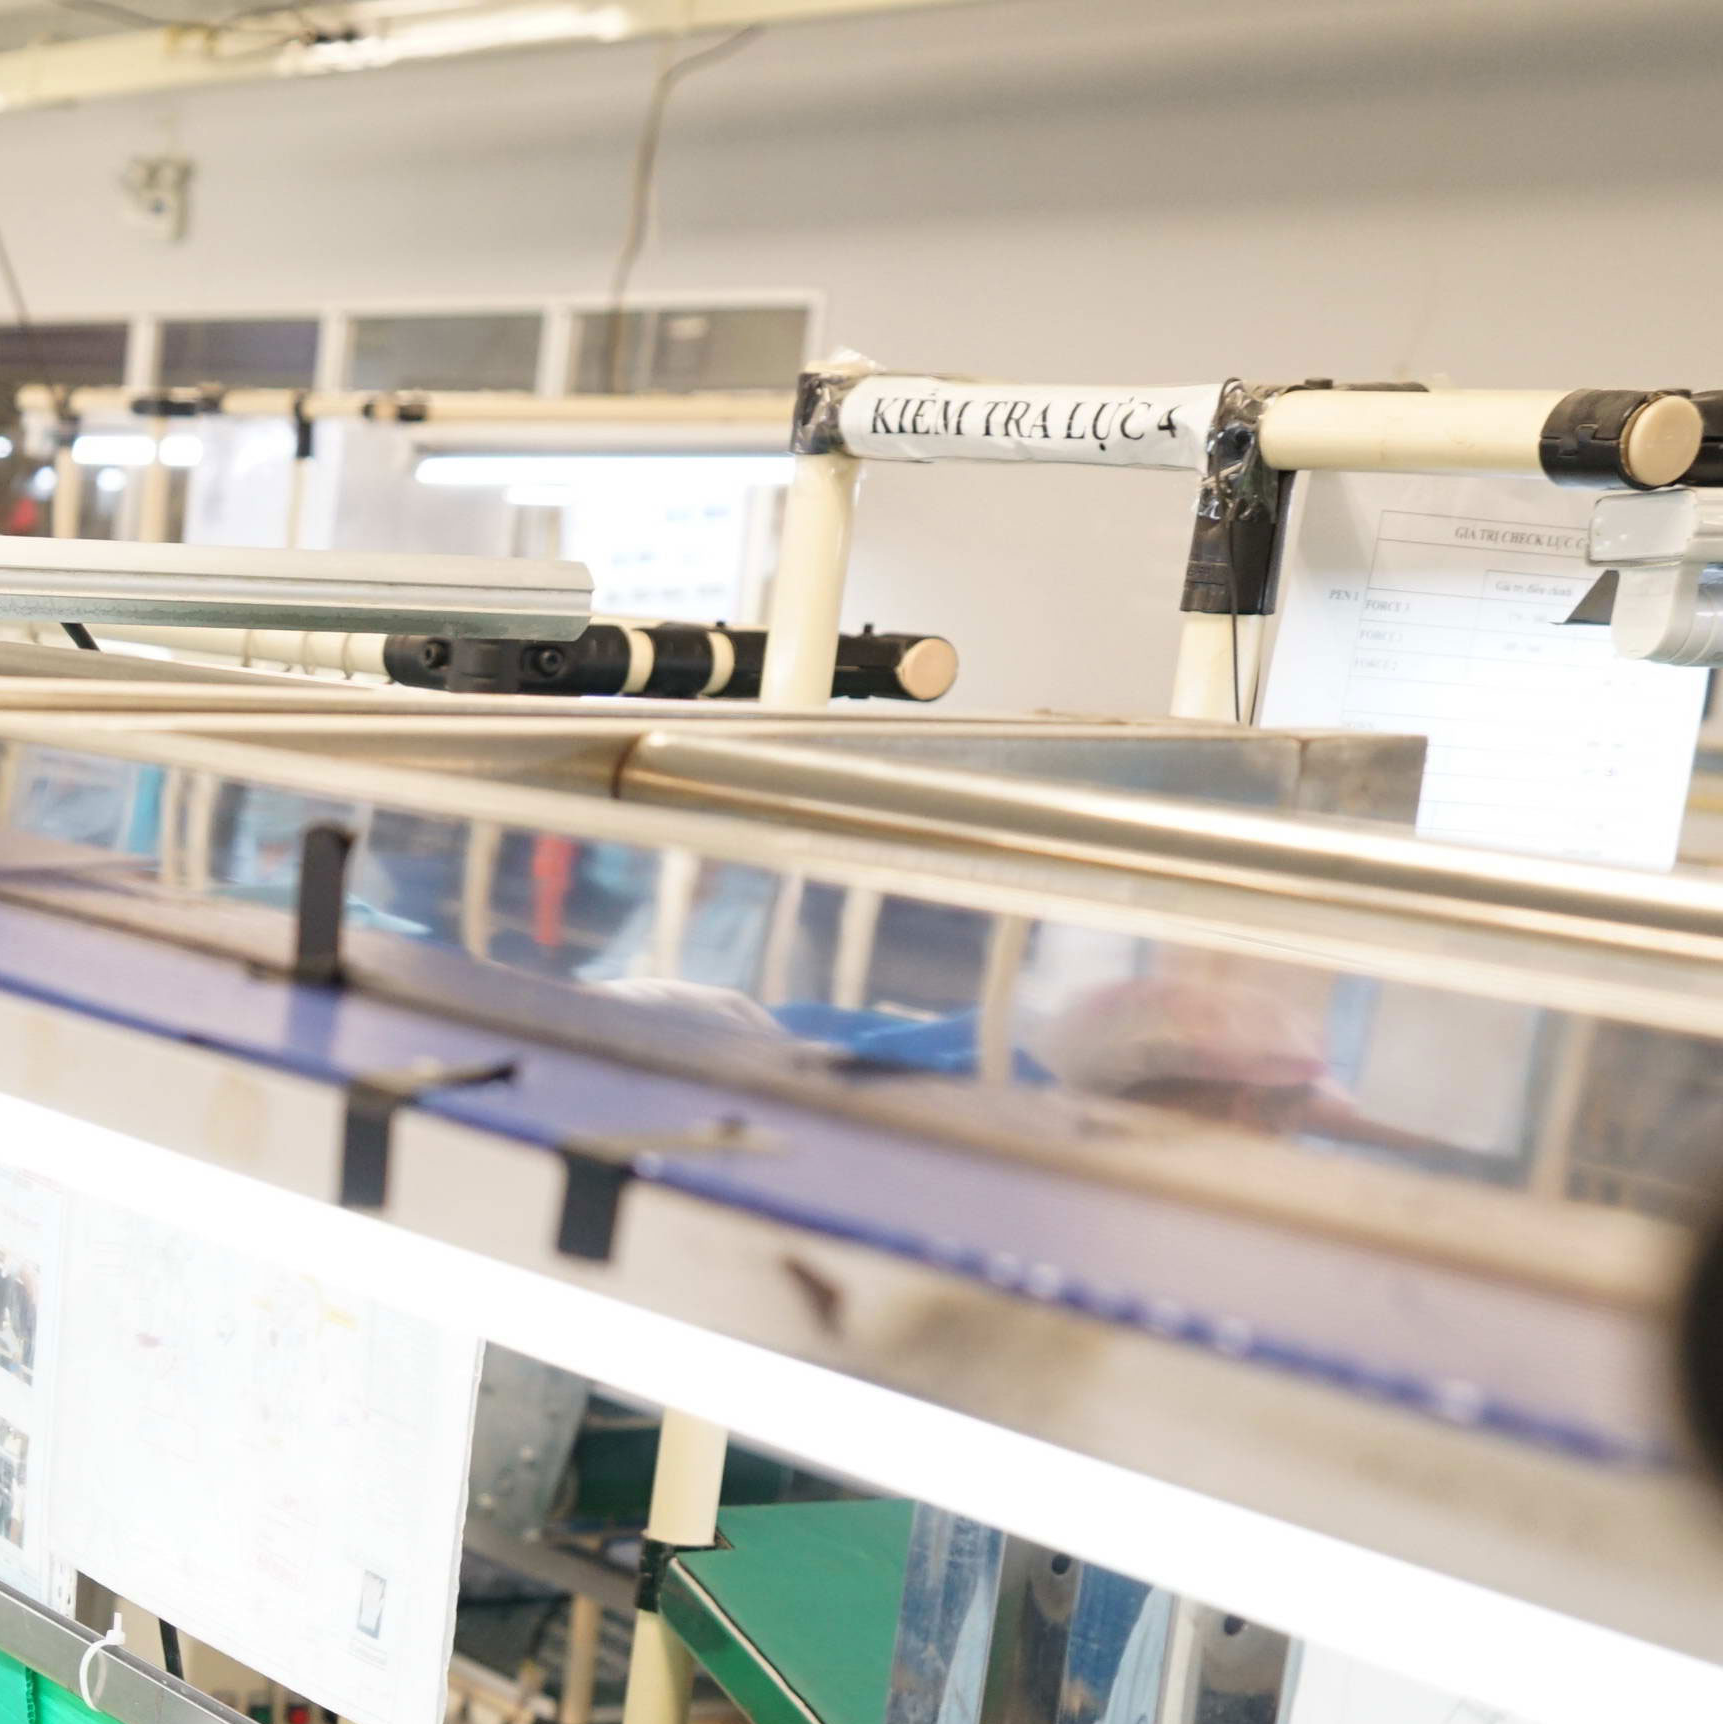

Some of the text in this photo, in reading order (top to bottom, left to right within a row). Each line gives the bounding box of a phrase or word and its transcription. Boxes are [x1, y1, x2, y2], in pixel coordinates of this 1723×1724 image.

[982, 400, 1052, 439] TRA
[1064, 396, 1152, 451] LỰC
[1501, 531, 1543, 547] CHECK
[1365, 599, 1402, 613] FORCE
